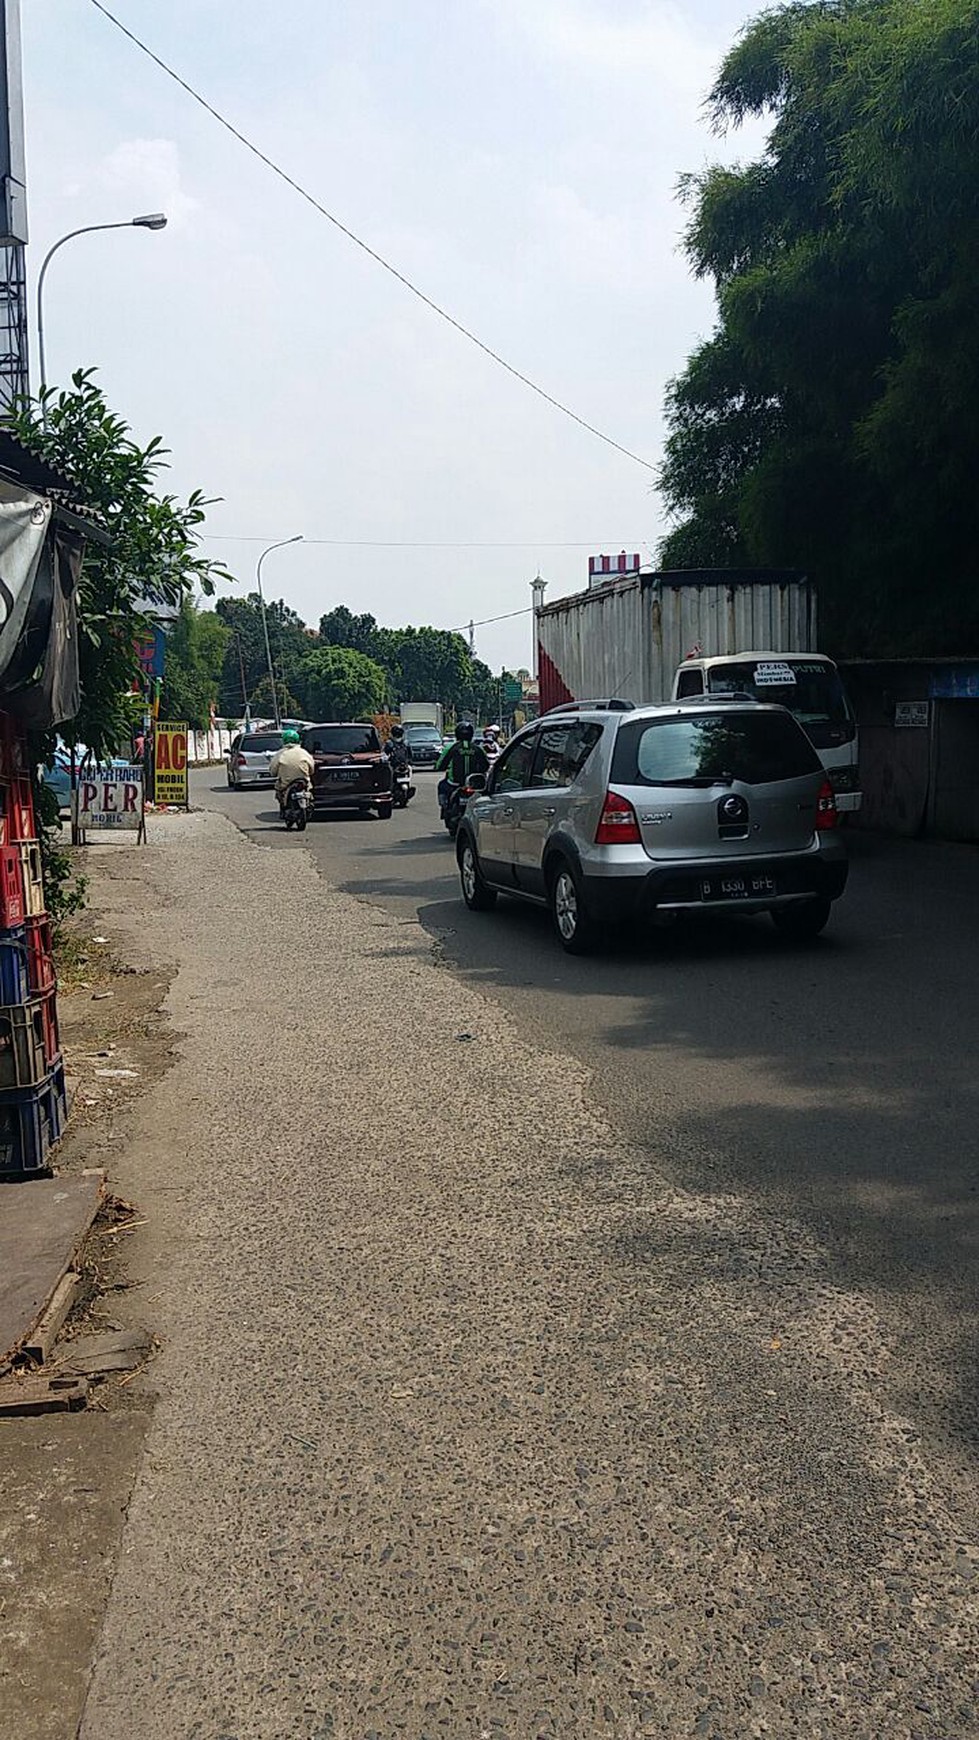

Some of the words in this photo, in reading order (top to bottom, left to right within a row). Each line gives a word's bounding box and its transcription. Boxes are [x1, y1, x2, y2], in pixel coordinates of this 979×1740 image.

[157, 724, 185, 732] SERVICE
[156, 733, 186, 771] AC
[157, 774, 185, 784] MOBIL
[81, 782, 138, 813] PER
[703, 880, 711, 894] B
